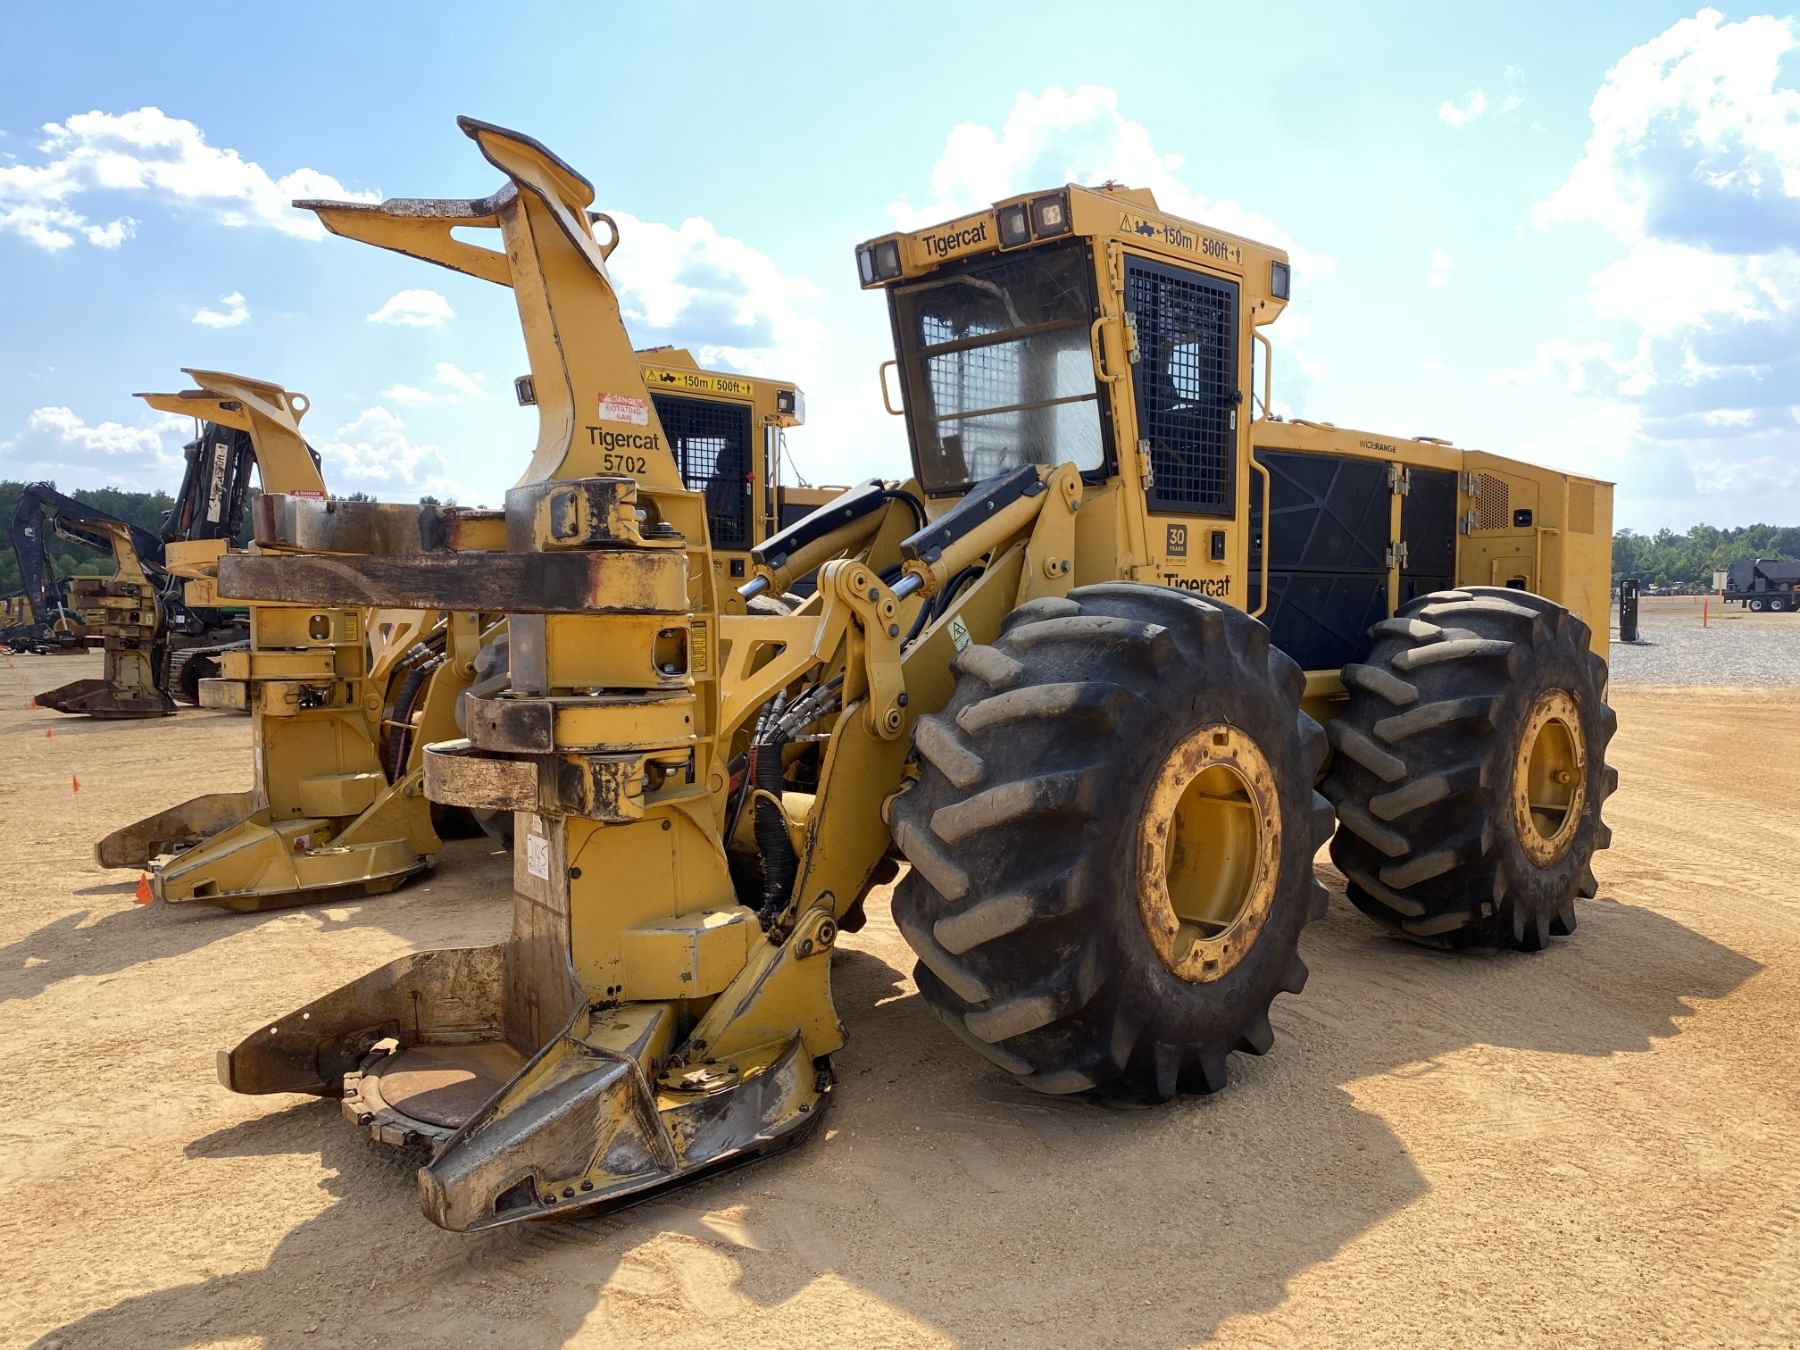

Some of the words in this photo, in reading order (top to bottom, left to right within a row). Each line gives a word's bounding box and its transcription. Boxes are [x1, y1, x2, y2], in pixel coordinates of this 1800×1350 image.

[922, 220, 988, 258] Tigercat
[1163, 224, 1193, 250] 150m
[1195, 233, 1200, 251] /
[1202, 238, 1229, 260] 500ft
[684, 375, 708, 389] 150m
[717, 380, 740, 393] 500ft
[585, 425, 660, 452] Tigercat
[604, 453, 647, 474] 5702
[1170, 529, 1185, 545] 30
[1163, 573, 1232, 598] Tigercat
